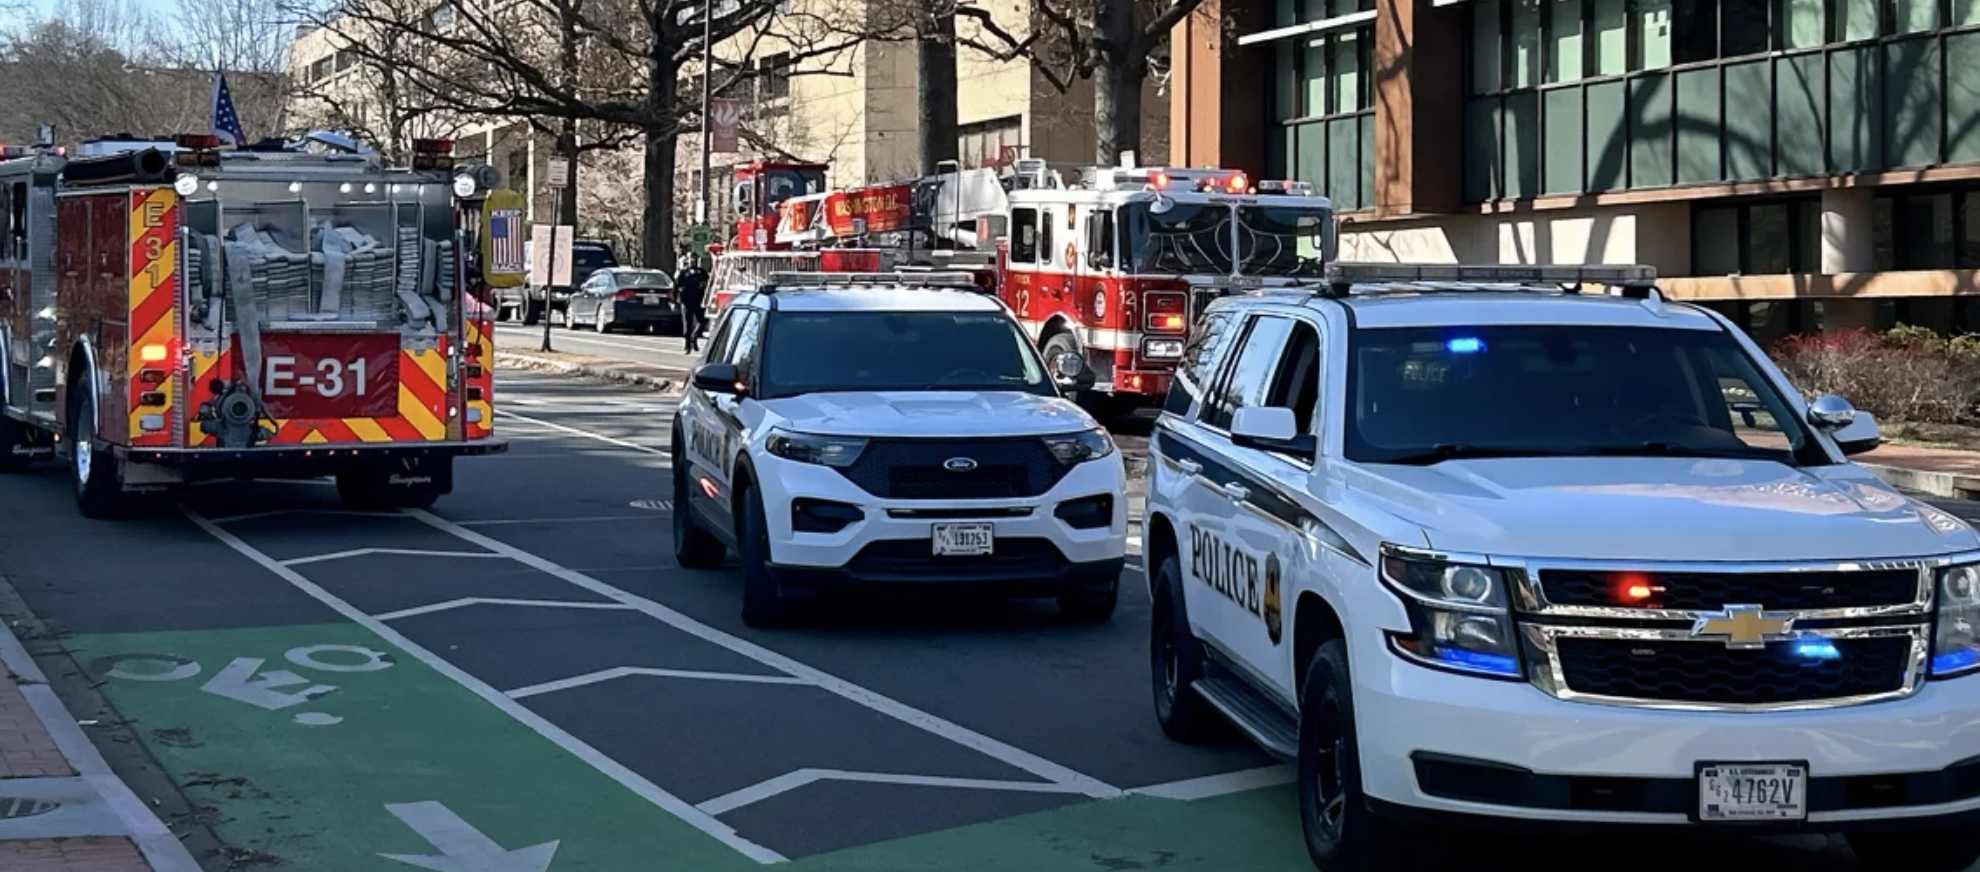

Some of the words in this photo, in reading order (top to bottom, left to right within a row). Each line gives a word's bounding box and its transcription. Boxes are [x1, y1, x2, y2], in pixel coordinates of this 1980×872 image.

[491, 209, 521, 218] KEEP
[1016, 290, 1029, 317] 12
[265, 356, 366, 397] E-31
[1190, 522, 1261, 619] POLICE
[1732, 778, 1793, 804] 4762V
